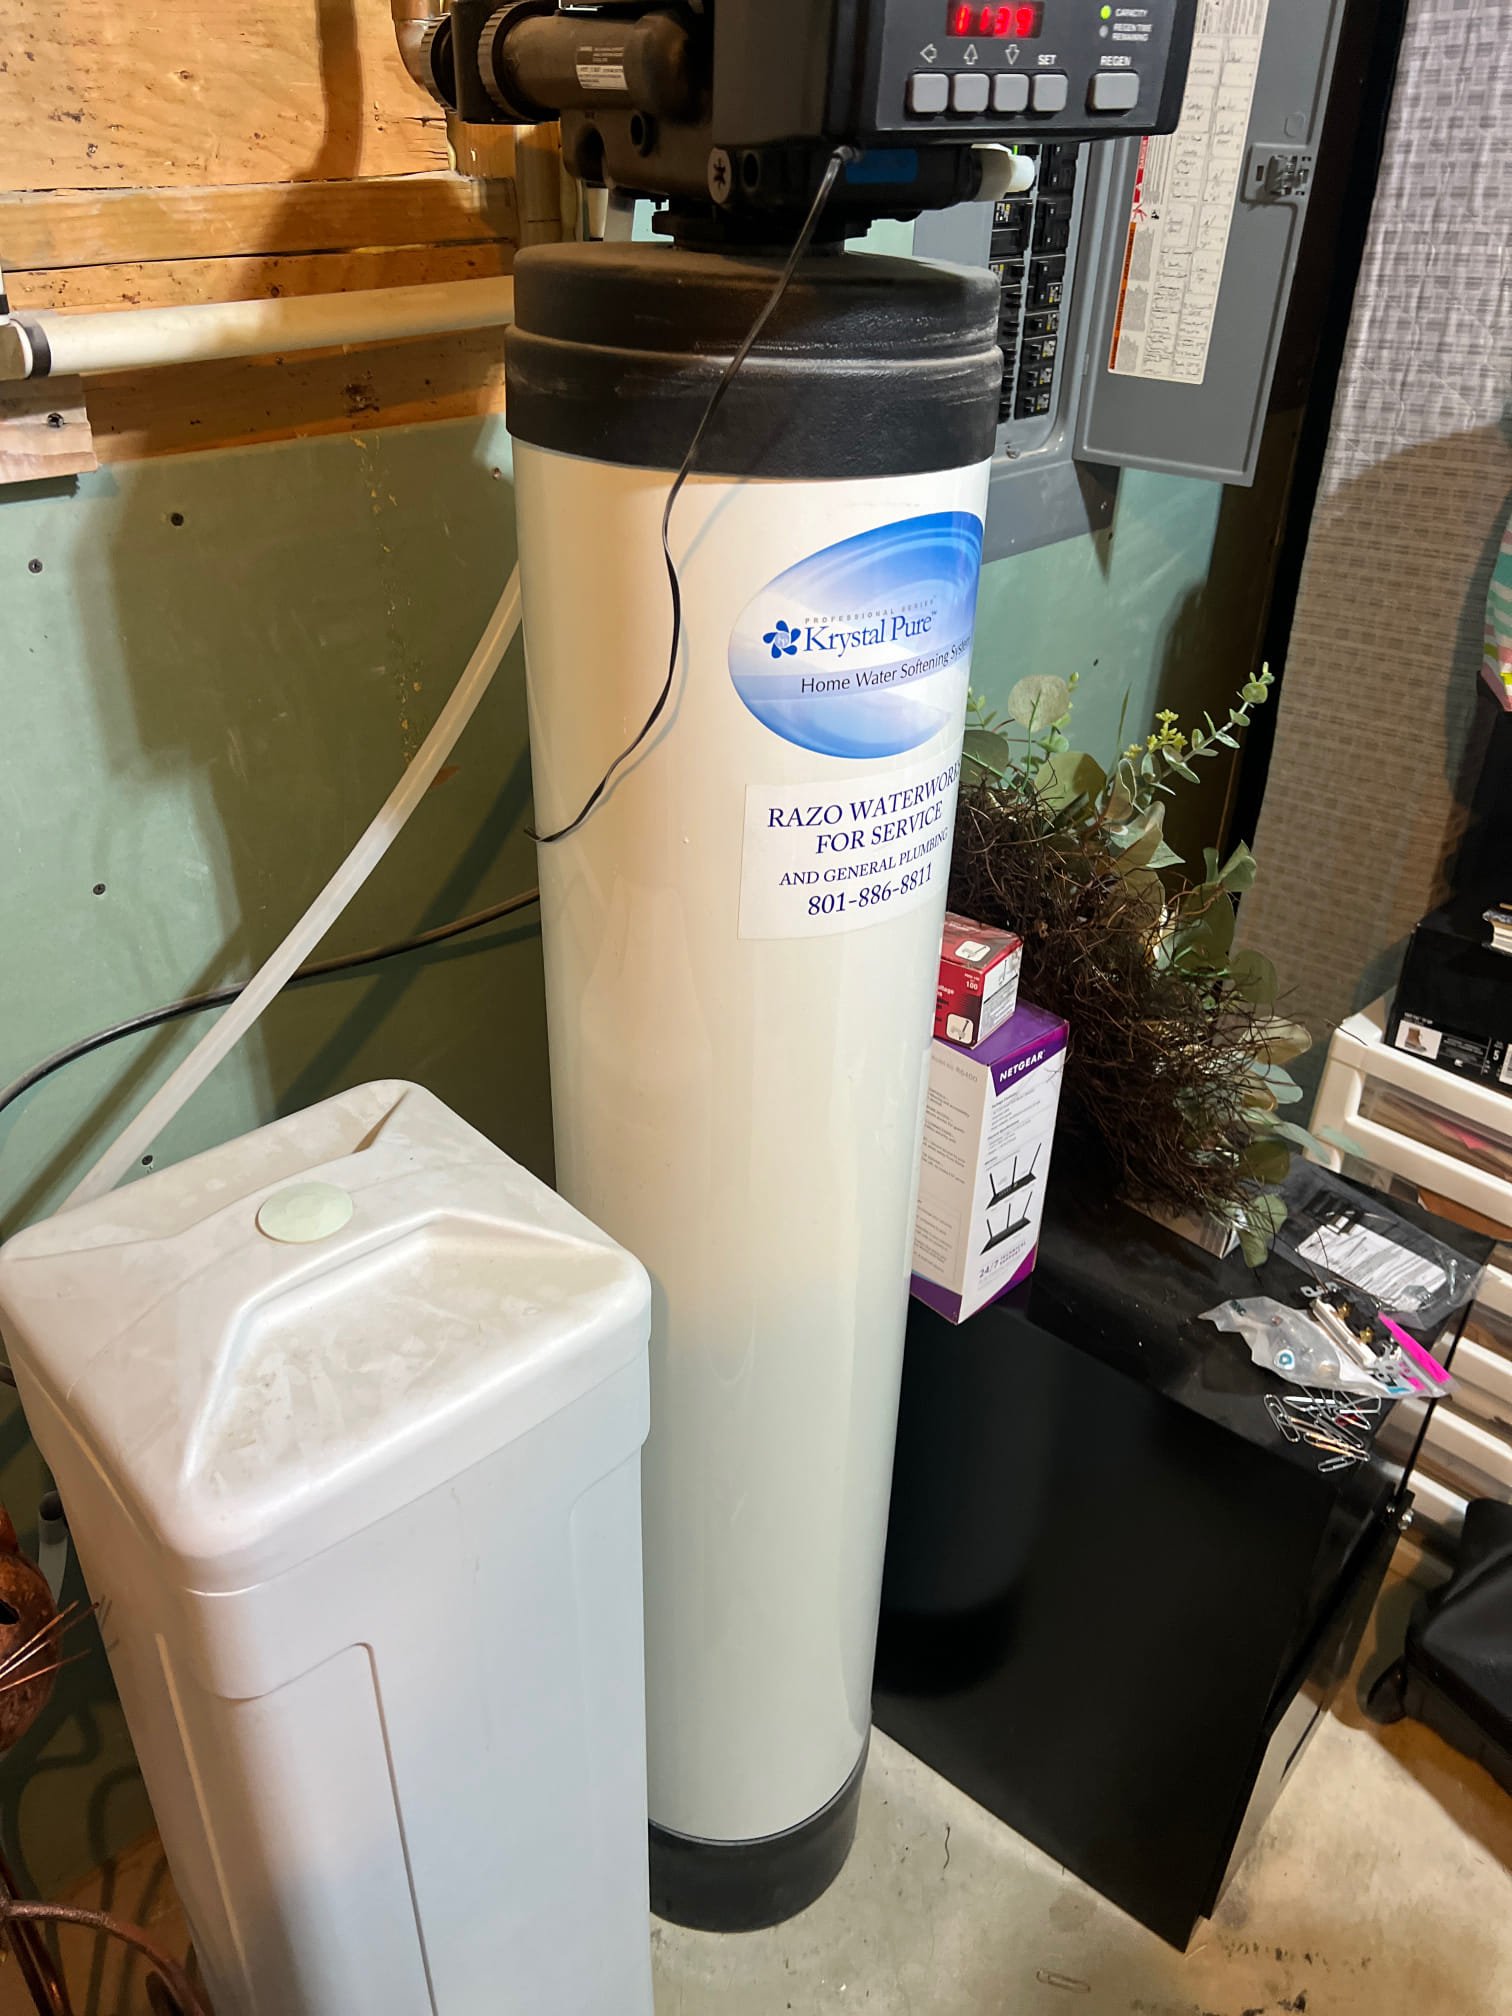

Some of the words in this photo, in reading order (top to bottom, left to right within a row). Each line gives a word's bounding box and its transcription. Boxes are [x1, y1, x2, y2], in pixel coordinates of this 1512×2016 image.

[1038, 54, 1056, 65] SET
[1100, 55, 1131, 66] REGEN
[804, 607, 895, 625] PROFESSIONAL
[803, 618, 886, 658] Krystal
[801, 677, 850, 693] Home
[856, 669, 897, 688] Water
[900, 652, 949, 679] Softening
[768, 804, 843, 828] RAZO
[816, 829, 866, 854] FOR
[871, 800, 943, 845] SERVICE
[779, 871, 819, 885] AND
[823, 856, 896, 882] GENERAL
[899, 827, 948, 866] PLUMBING
[808, 861, 932, 916] 801-886-8811
[966, 981, 978, 991] 100
[1493, 1049, 1501, 1061] 5
